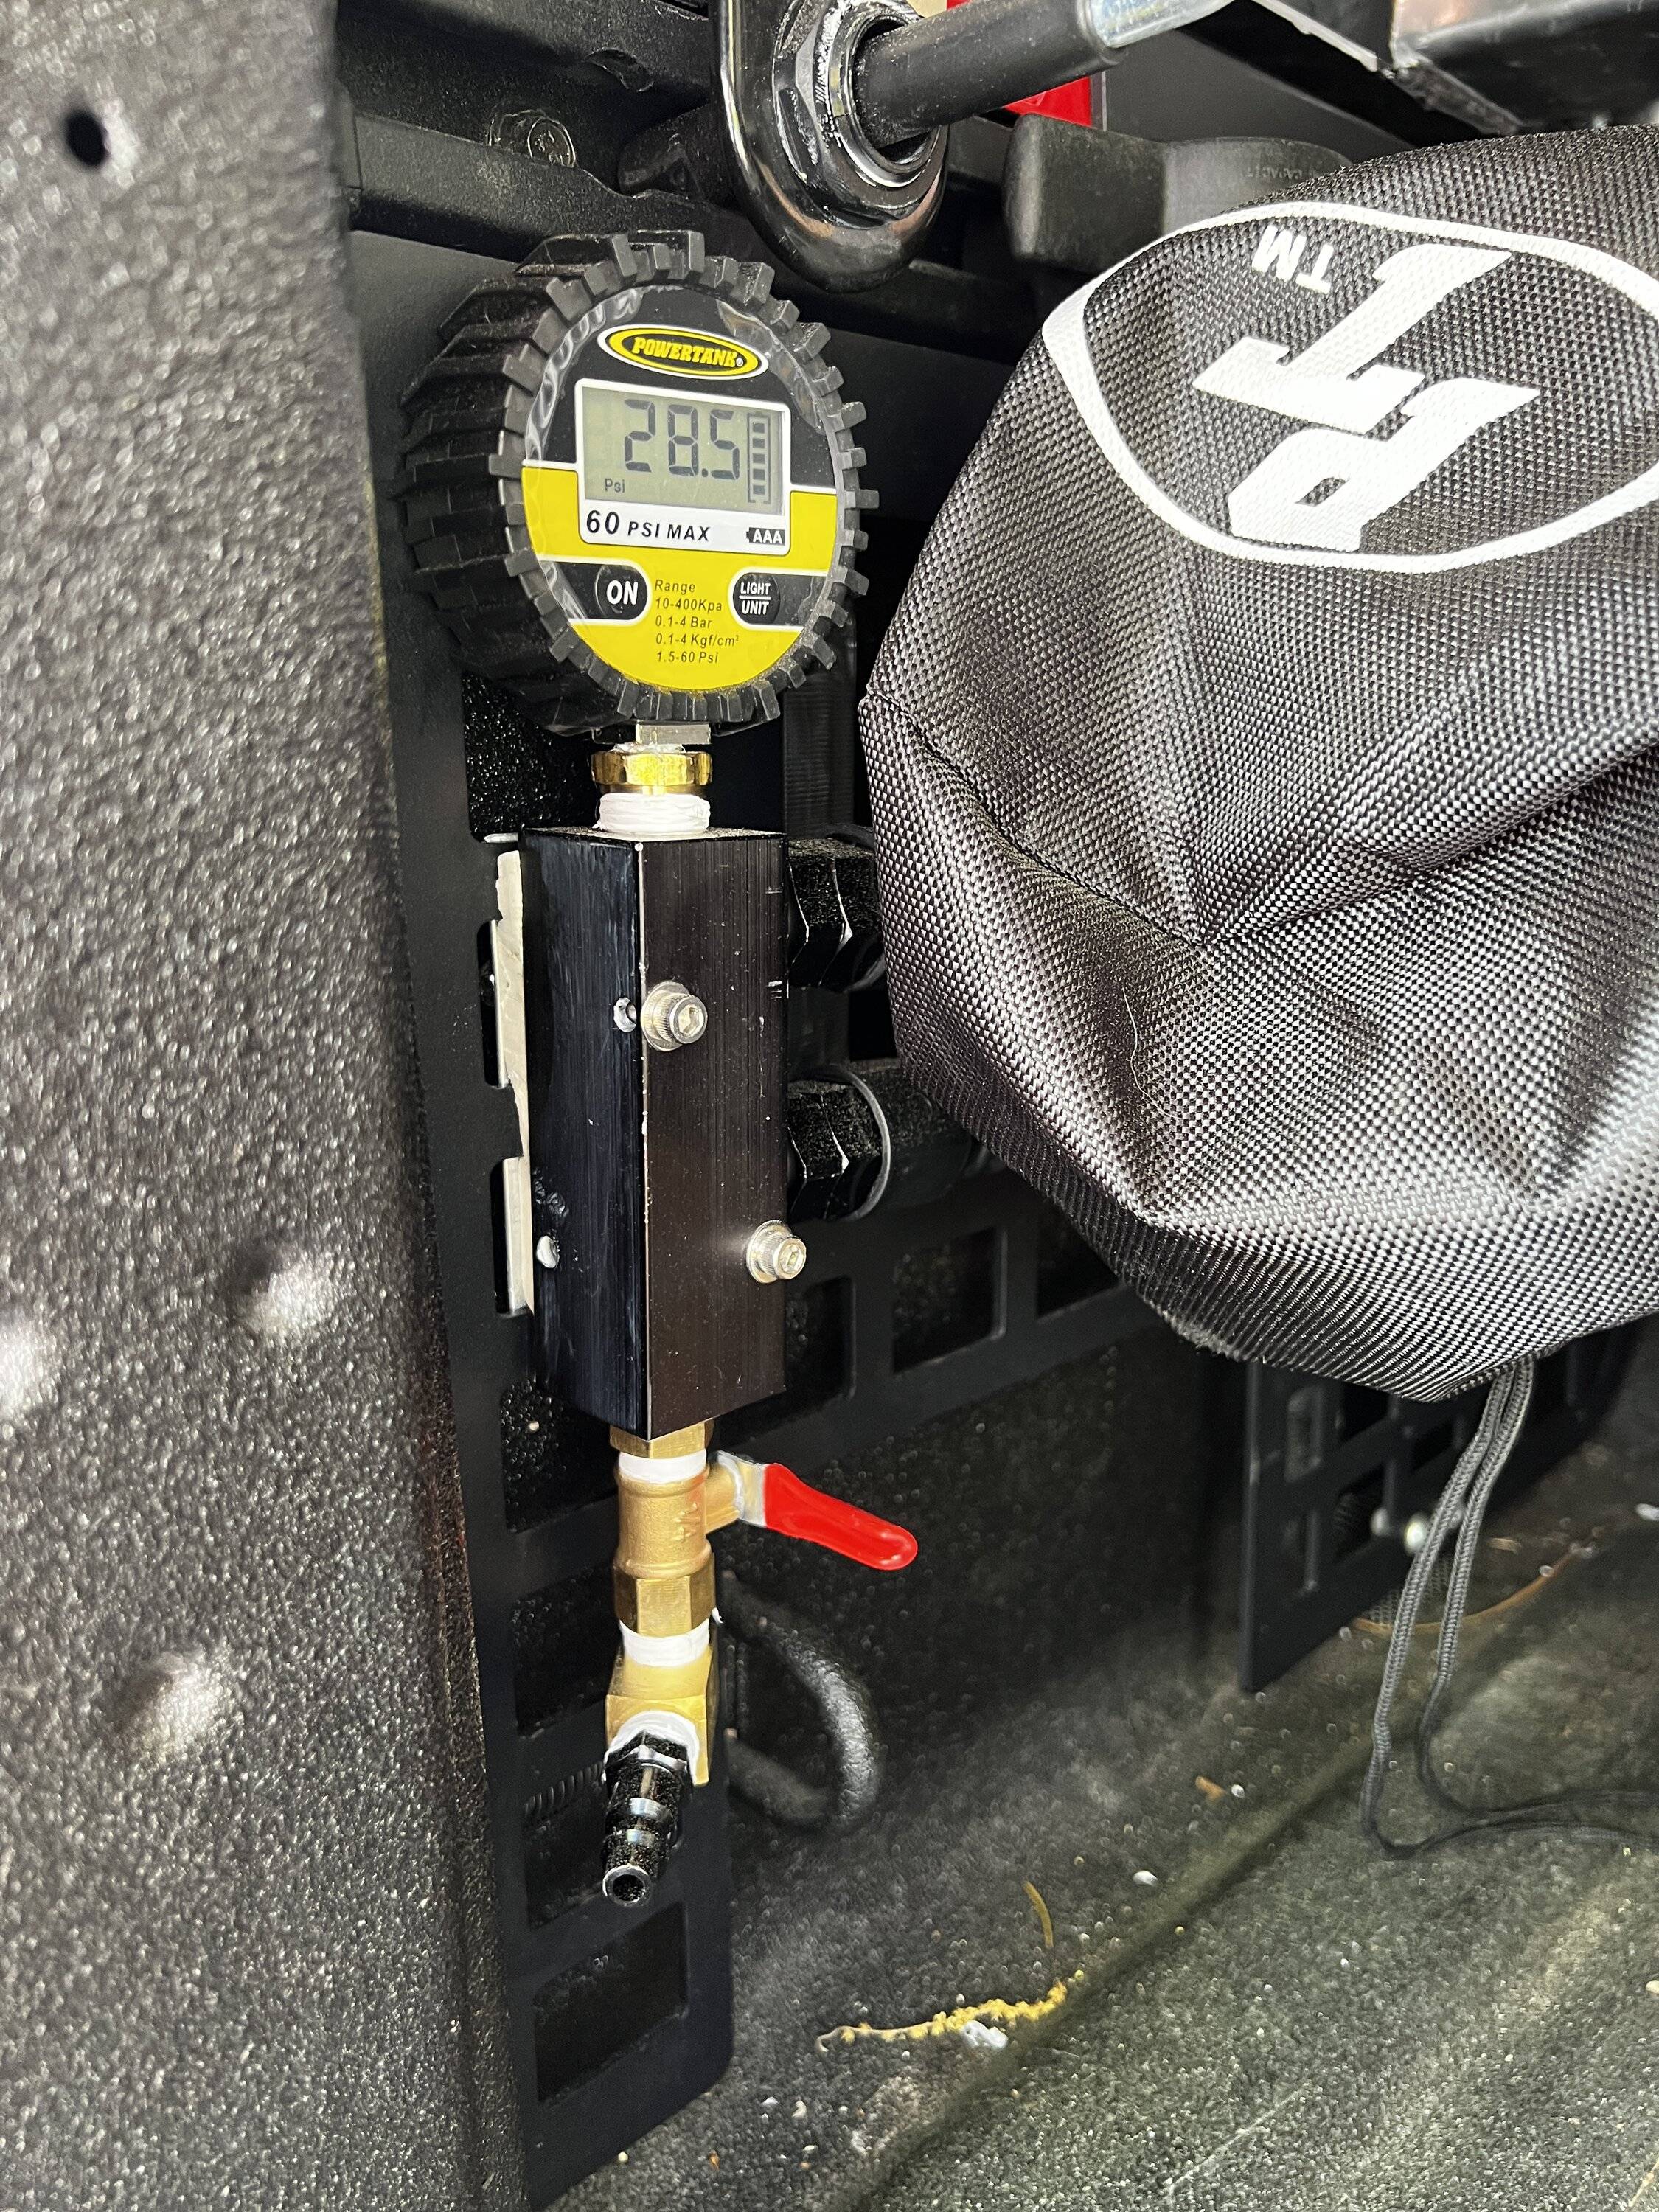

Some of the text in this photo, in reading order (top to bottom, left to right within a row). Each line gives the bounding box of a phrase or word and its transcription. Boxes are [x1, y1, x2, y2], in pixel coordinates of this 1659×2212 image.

[1251, 225, 1335, 292] TM
[625, 399, 740, 480] 28.5
[605, 478, 625, 493] Psi
[586, 509, 711, 542] 60 PSI MAX
[753, 529, 783, 544] AAA
[606, 580, 639, 605] ON
[654, 579, 695, 595] Range
[740, 581, 771, 595] LIGHT
[655, 598, 723, 613] 10-400Kpa
[741, 599, 769, 615] UNIT
[655, 615, 713, 628] 0.1-4 Bar
[655, 633, 686, 646] 0.1-4
[657, 652, 719, 664] 1.5-60 Psi
